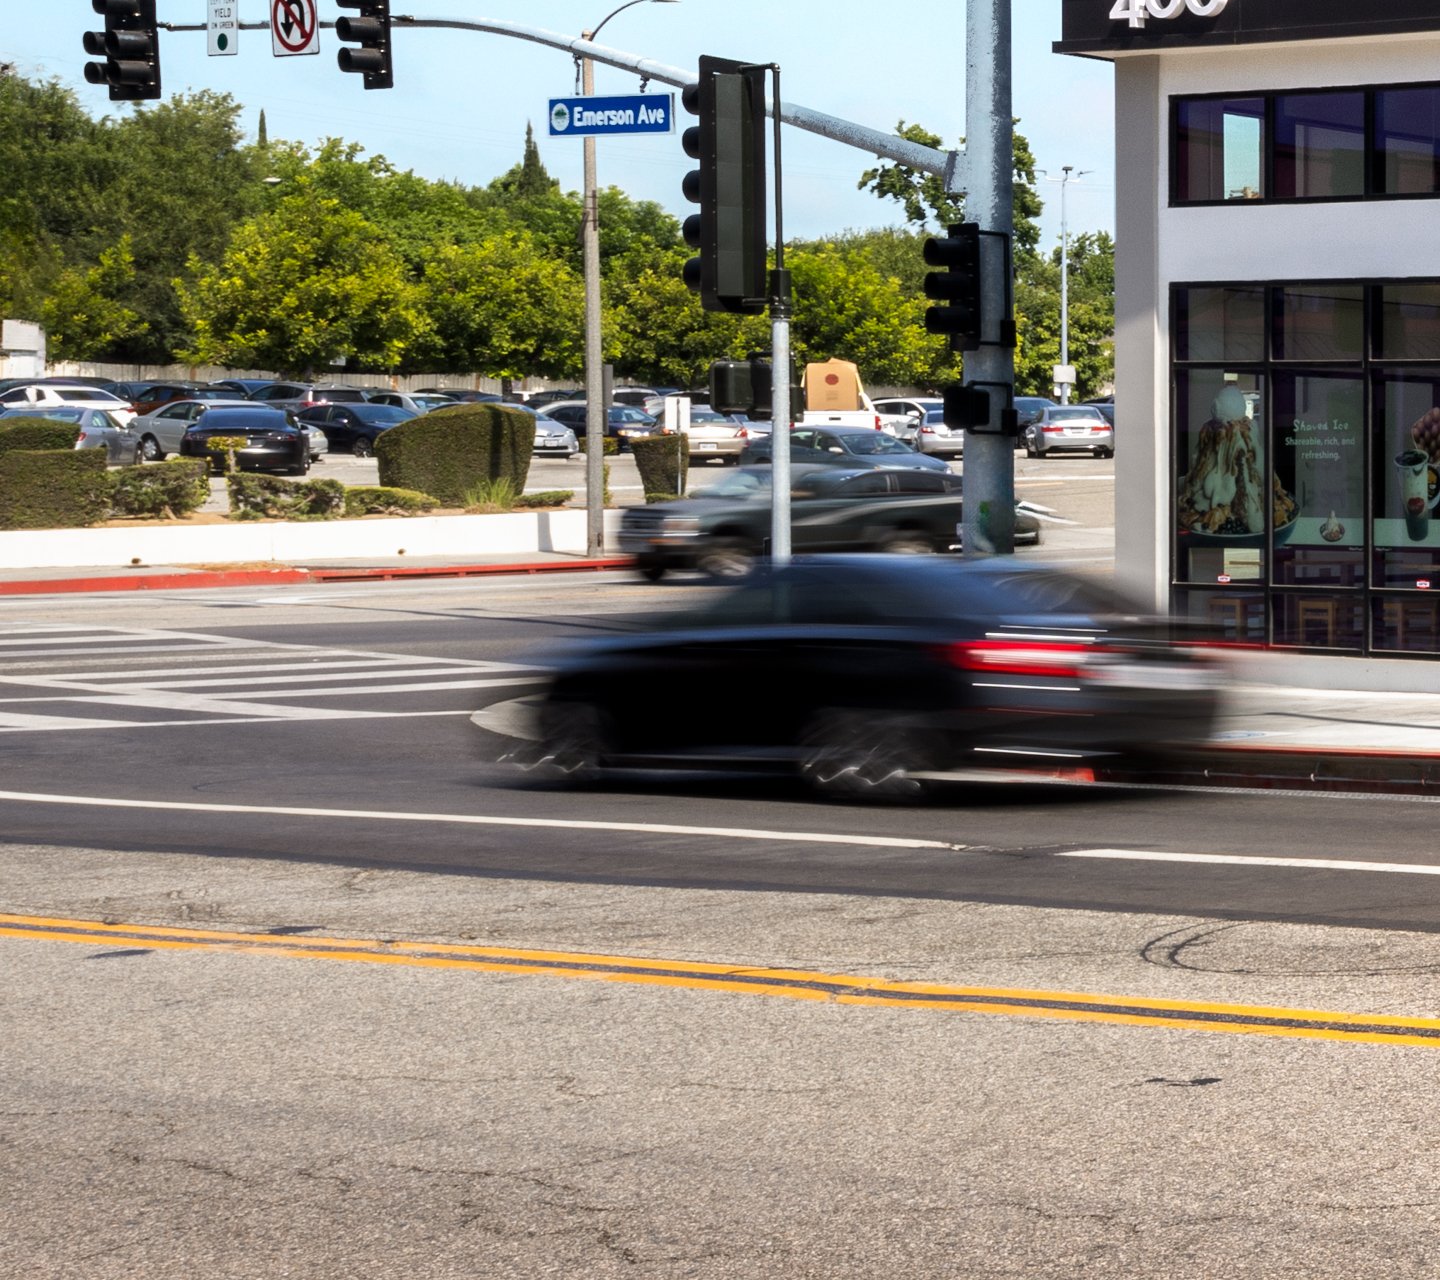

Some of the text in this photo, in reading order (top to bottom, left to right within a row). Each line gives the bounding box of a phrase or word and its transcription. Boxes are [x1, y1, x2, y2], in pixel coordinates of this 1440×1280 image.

[214, 8, 231, 17] YIELD
[573, 104, 665, 127] Emerson Ave
[1293, 419, 1349, 432] Shaved Ice
[1285, 437, 1323, 446] Shareable,
[1341, 437, 1355, 445] and
